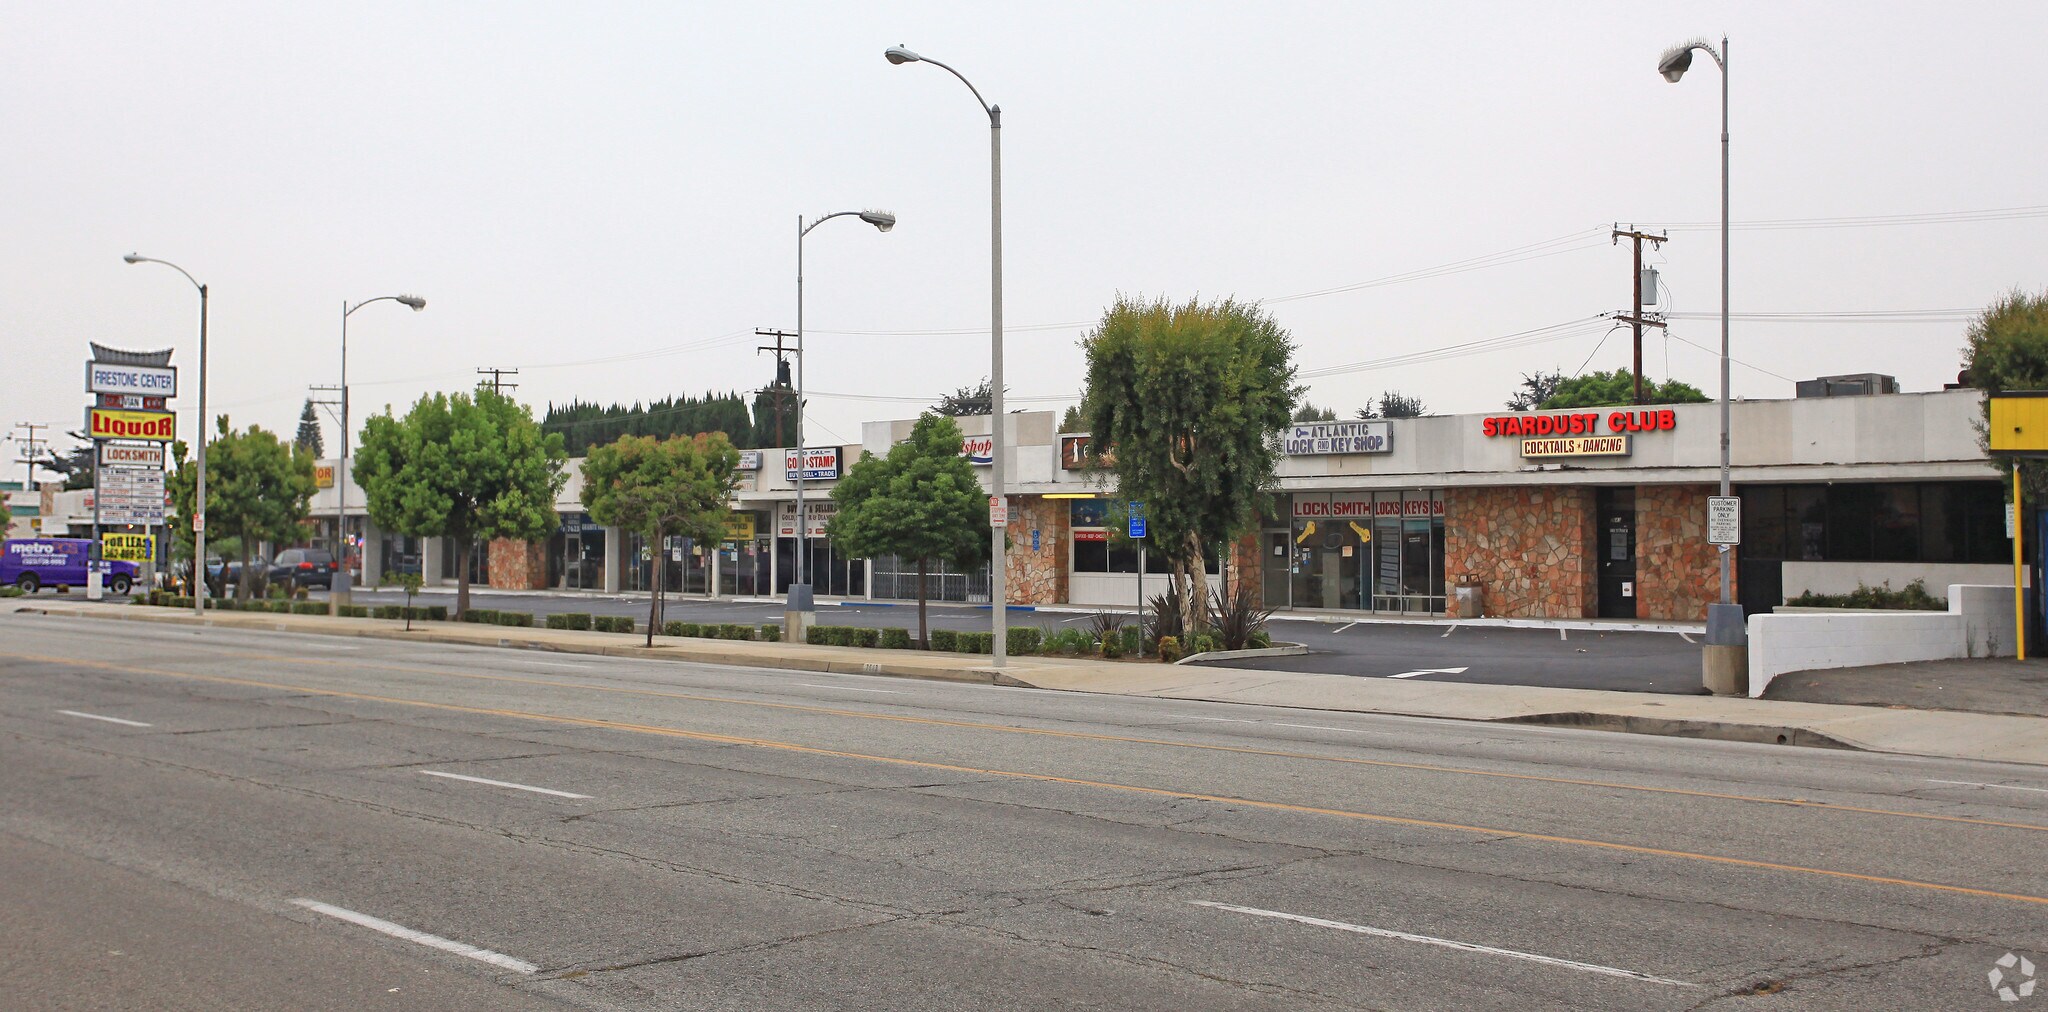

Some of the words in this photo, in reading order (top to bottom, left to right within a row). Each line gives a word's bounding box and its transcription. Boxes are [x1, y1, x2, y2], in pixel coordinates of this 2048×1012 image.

[95, 371, 138, 387] FIRESTONE
[141, 374, 172, 389] CENTER
[93, 412, 172, 437] LIQUOR
[1311, 424, 1369, 438] ATLANTIC
[1483, 413, 1599, 437] STARDUST
[1608, 409, 1676, 434] CLUB
[1286, 439, 1315, 454] LOCK
[1318, 440, 1330, 450] AND
[1331, 437, 1353, 452] KEY
[1354, 436, 1384, 451] SHOP
[1524, 440, 1575, 455] COCKTAILS
[1583, 438, 1622, 453] DANCING
[107, 449, 161, 462] LOCKSMITH
[810, 456, 836, 468] STAMP
[818, 470, 835, 478] TRADE
[1294, 502, 1331, 516] LOCK
[1333, 502, 1371, 516] SMITH
[1375, 501, 1400, 515] LOCKS
[1404, 500, 1429, 514] KEYS
[1433, 500, 1444, 515] SA
[105, 537, 124, 547] FOR
